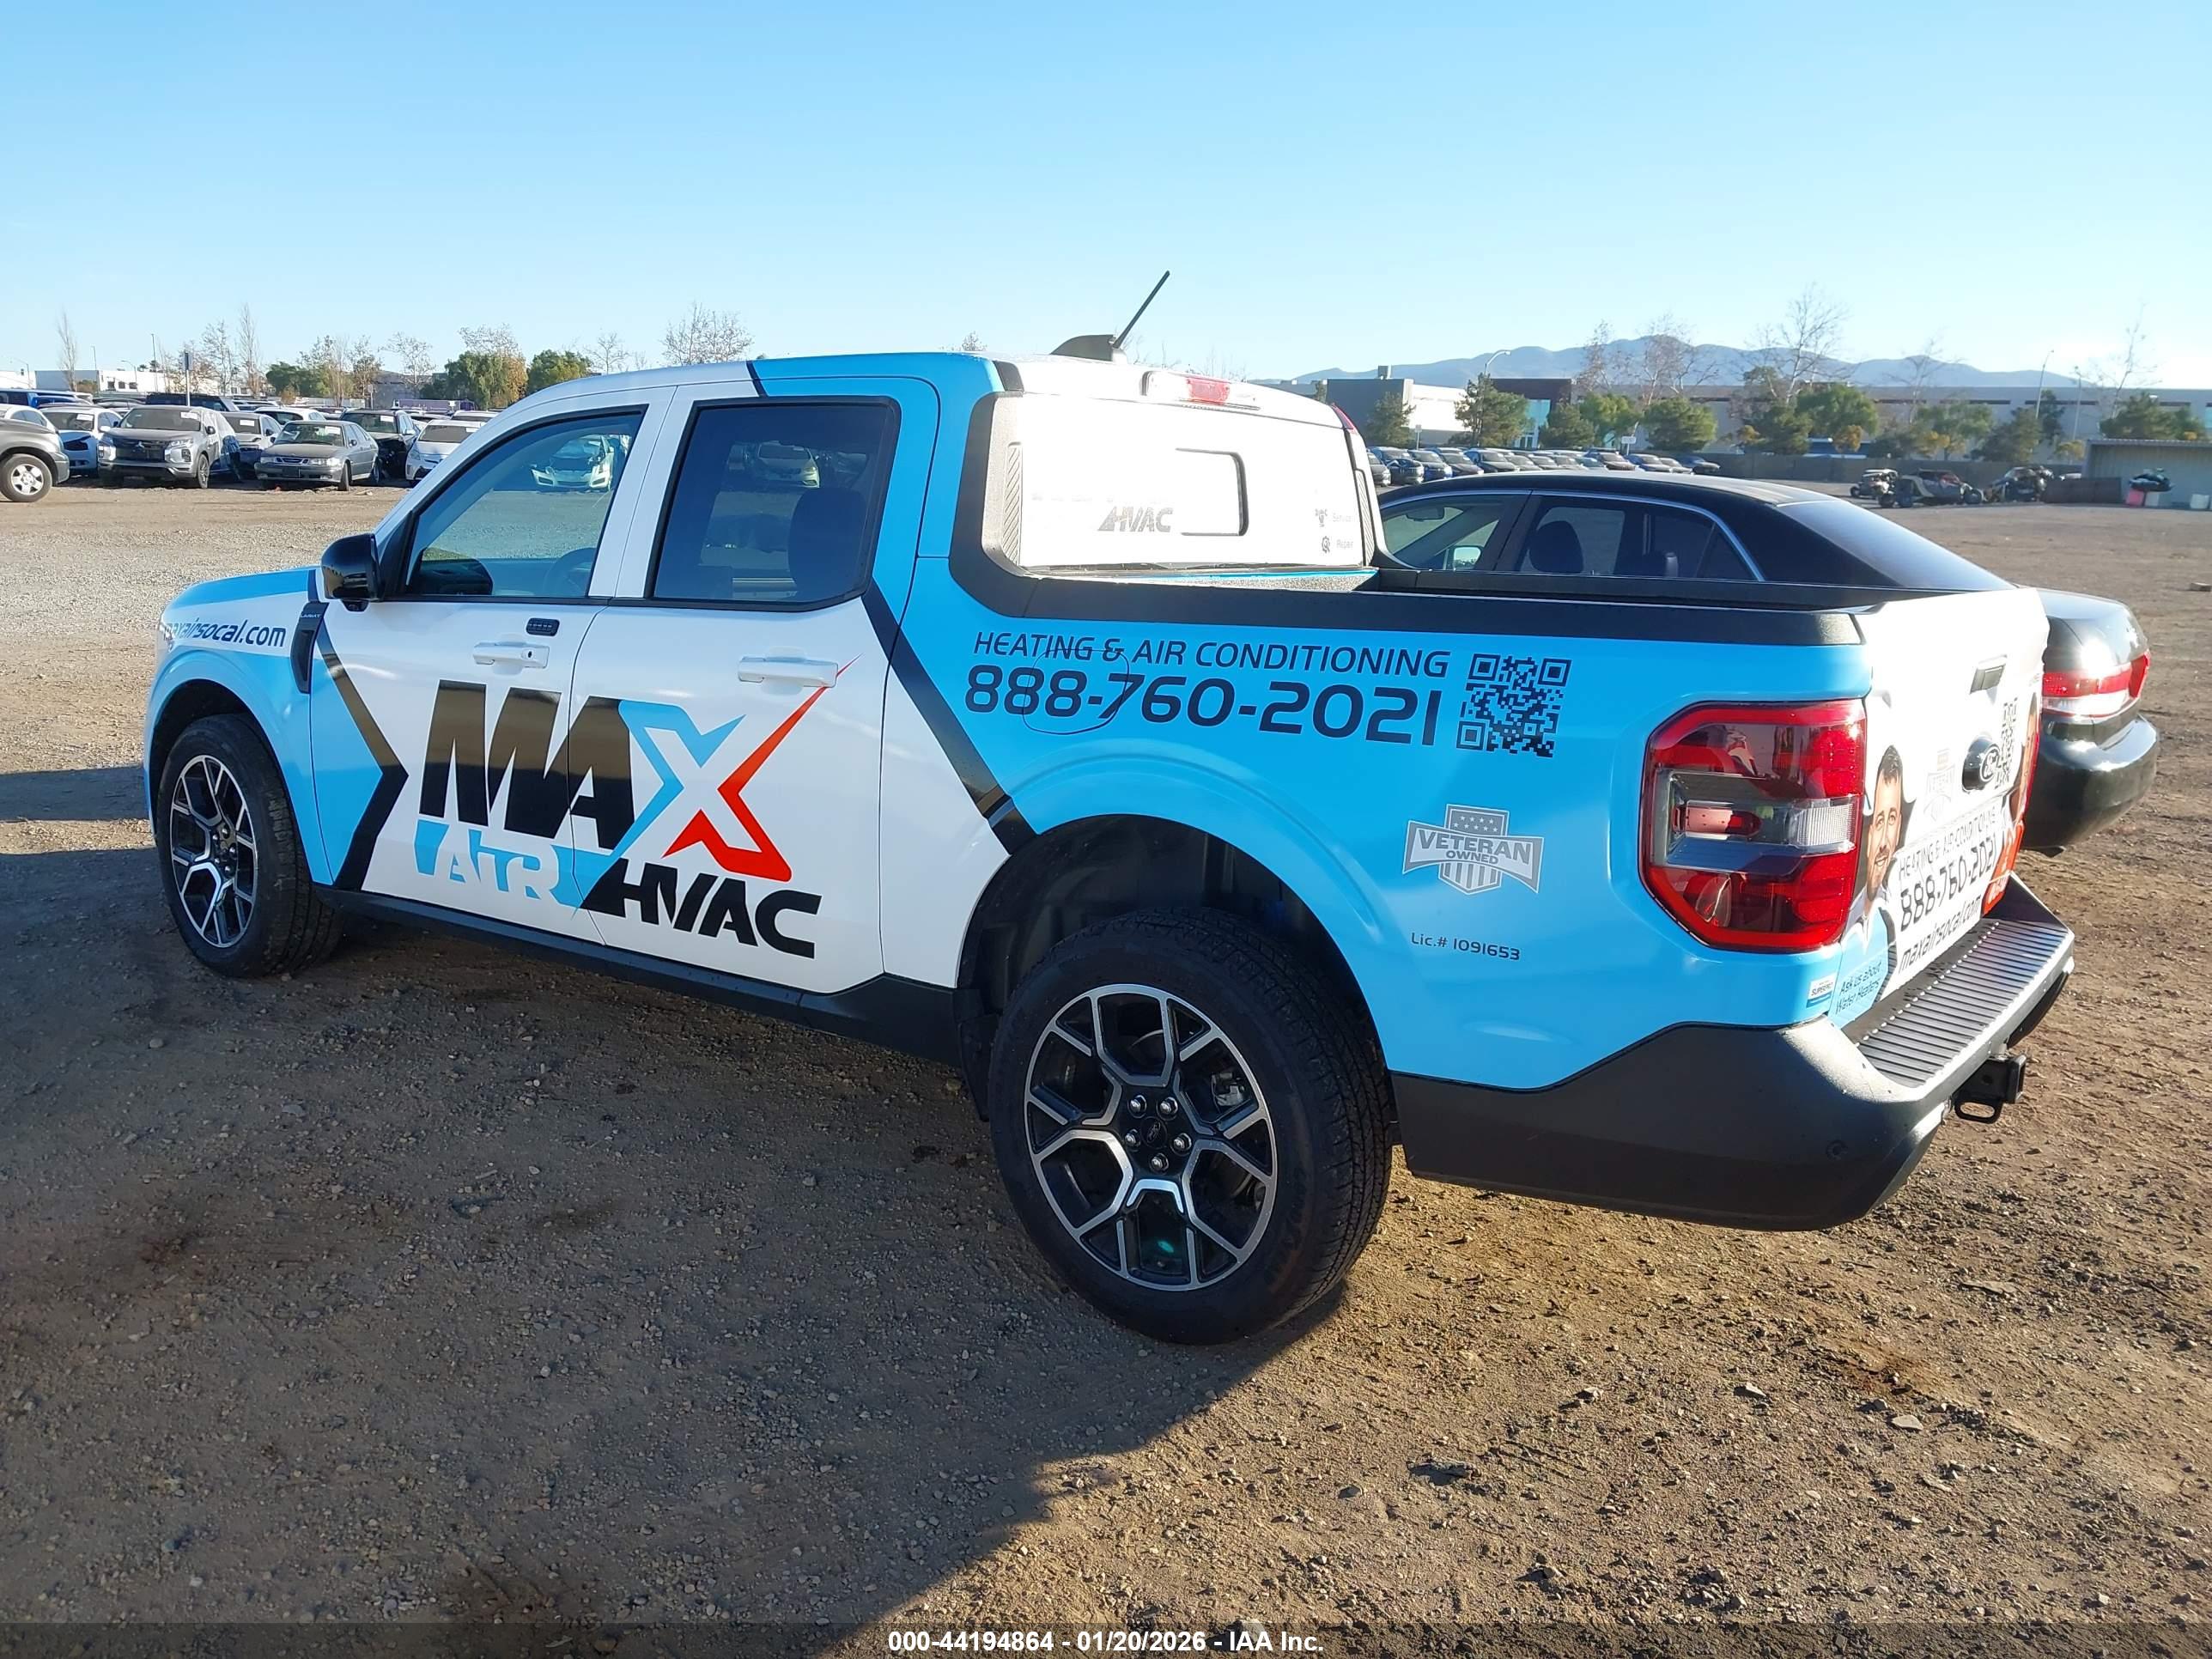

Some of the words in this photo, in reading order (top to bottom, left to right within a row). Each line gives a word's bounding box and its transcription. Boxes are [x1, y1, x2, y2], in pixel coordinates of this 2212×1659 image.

[1097, 506, 1174, 533] HVAC
[974, 632, 1093, 661] HEATING
[1102, 637, 1123, 661] &
[1132, 640, 1187, 667] AIR
[1195, 641, 1450, 678] CONDITIONING
[965, 665, 1442, 746] 888-760-2021
[419, 656, 862, 883] MAX
[1419, 830, 1531, 865] VETERAN
[1446, 850, 1499, 865] OWNED
[583, 858, 823, 960] HVAC
[1411, 933, 1448, 948] Lic.#
[1453, 938, 1521, 961] 1091653
